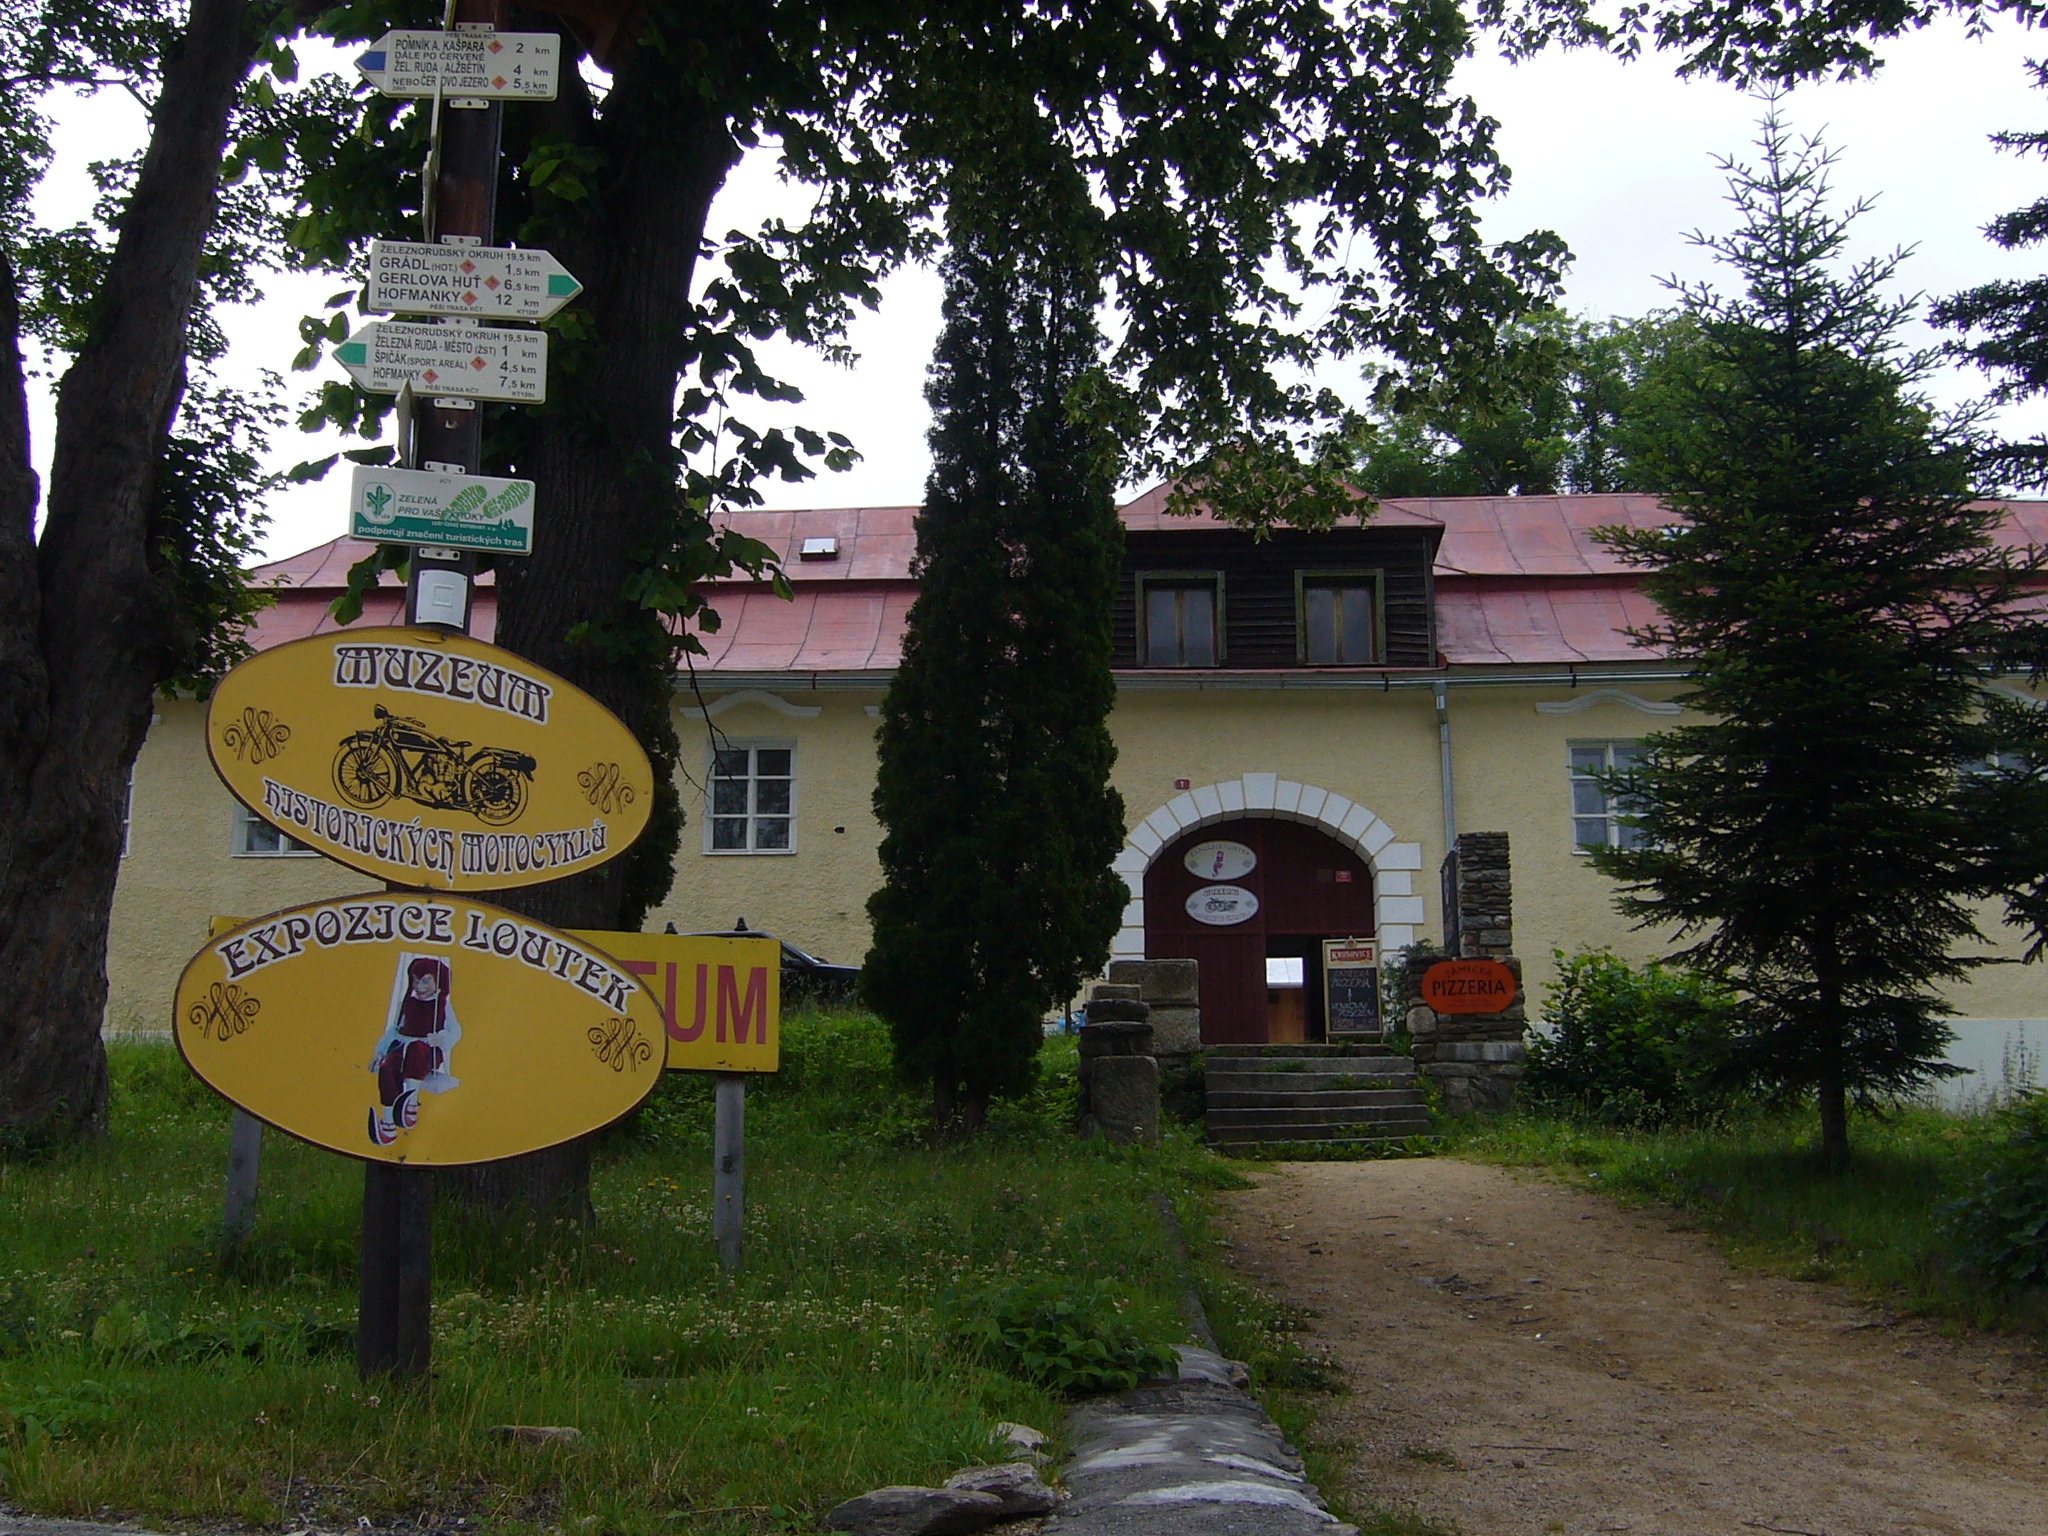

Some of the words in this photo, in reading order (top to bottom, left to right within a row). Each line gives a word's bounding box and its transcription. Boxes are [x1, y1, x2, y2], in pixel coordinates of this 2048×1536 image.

[395, 38, 431, 50] POMNÍK
[443, 37, 485, 52] KAŠPARA
[515, 43, 524, 54] 2
[535, 47, 550, 55] km
[394, 50, 421, 60] DÁLE
[423, 52, 437, 60] PO
[439, 50, 486, 62] ČERVENÉ
[414, 62, 438, 73] RUDA
[444, 62, 486, 74] ALŽBĚTÍN
[513, 64, 522, 76] 4
[534, 68, 549, 77] km
[392, 78, 420, 86] NEBO
[420, 74, 458, 88] ČEROVO
[459, 77, 489, 88] JEZERO
[513, 78, 530, 90] 5,5
[532, 82, 548, 90] km
[380, 244, 465, 258] ŽELEZNORUDSKÝ
[468, 250, 504, 260] OKRUH
[506, 253, 525, 262] 19,5
[526, 254, 541, 263] km
[380, 256, 430, 271] GRÁDL
[431, 263, 458, 273] (HOT.)
[505, 264, 522, 277] 1,5
[524, 267, 540, 277] km
[379, 273, 449, 287] GERLOVA
[452, 274, 482, 289] HUŤ
[504, 279, 522, 292] 6,5
[524, 283, 540, 293] km
[378, 287, 461, 303] HOFMANKY
[495, 294, 513, 306] 12
[524, 299, 540, 308] km
[376, 324, 463, 339] ŽELEZNORUDSKÝ
[465, 331, 500, 341] OKRUH
[503, 334, 522, 343] 19,5
[524, 335, 539, 344] km
[375, 335, 412, 350] ŽELEZNÁ
[414, 340, 437, 351] RUDA
[444, 340, 473, 354] MĚSTO
[502, 345, 509, 356] 1
[522, 350, 538, 359] km
[374, 351, 407, 365] ŠPIČÁK
[439, 358, 468, 370] AREÁL)
[500, 360, 518, 373] 4,5
[521, 365, 537, 375] km
[373, 367, 421, 381] HOFMANKY
[500, 376, 517, 389] 7,5
[520, 380, 536, 390] km
[399, 495, 438, 506] ZELENÁ
[398, 507, 420, 517] PRO
[358, 525, 406, 538] podporují
[406, 529, 444, 540] značení
[445, 533, 502, 546] turistických
[504, 539, 524, 548] tras
[335, 646, 551, 722] MUZEUM
[264, 780, 455, 880] HISTORICKÝCH
[462, 818, 606, 875] MOTOCYKLŮ
[219, 905, 453, 978] EXPOZICE
[465, 914, 637, 1012] LOUTEK
[1432, 980, 1507, 996] PIZZERIA
[625, 961, 768, 1045] UM
